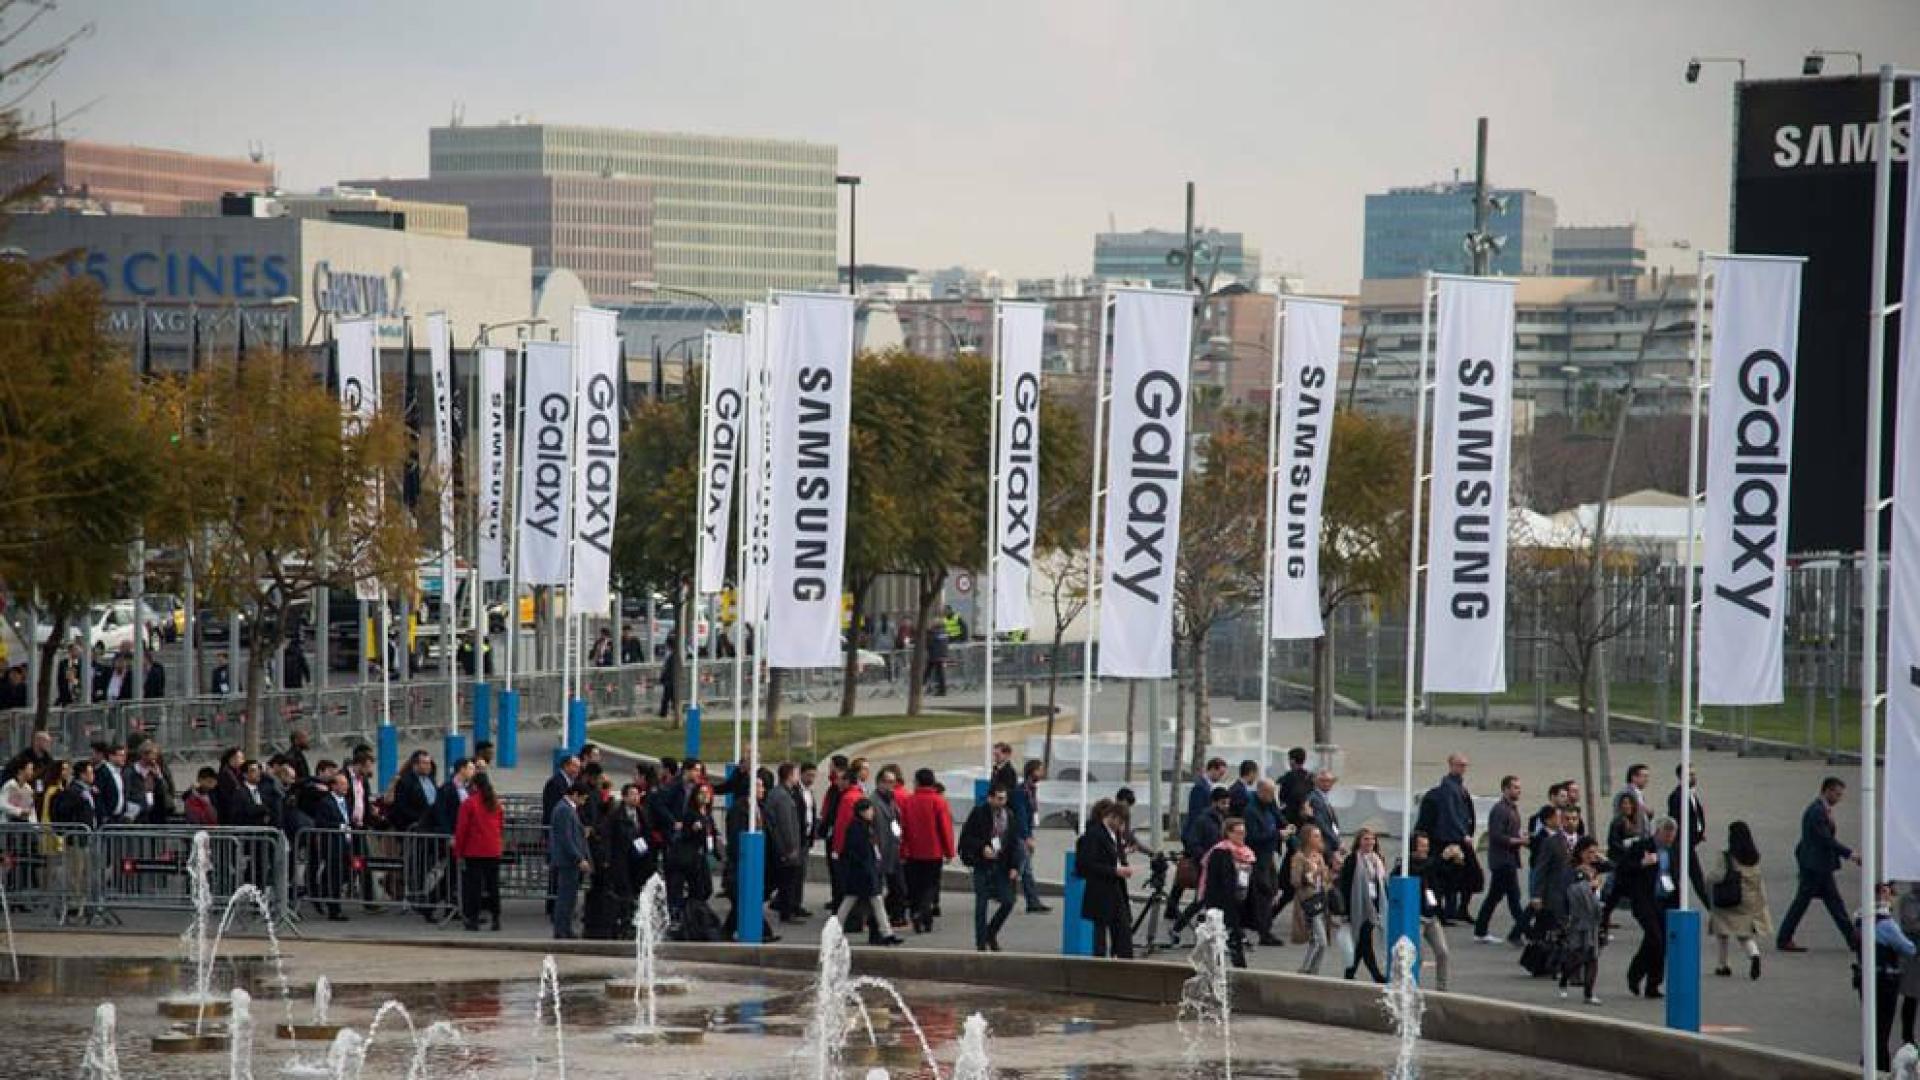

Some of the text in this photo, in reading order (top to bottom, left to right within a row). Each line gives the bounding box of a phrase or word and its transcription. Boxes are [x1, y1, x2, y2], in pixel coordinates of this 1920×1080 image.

[123, 250, 290, 297] CINES
[525, 393, 570, 538] Galaxy
[579, 373, 616, 555] Galaxy
[792, 367, 833, 602] SAMSUNG
[1001, 372, 1039, 567] Galaxy
[1112, 370, 1182, 604] Galaxy
[1287, 365, 1326, 579] SAMSUNG
[1450, 358, 1495, 620] SAMSUNG
[1714, 348, 1791, 620] Galaxy
